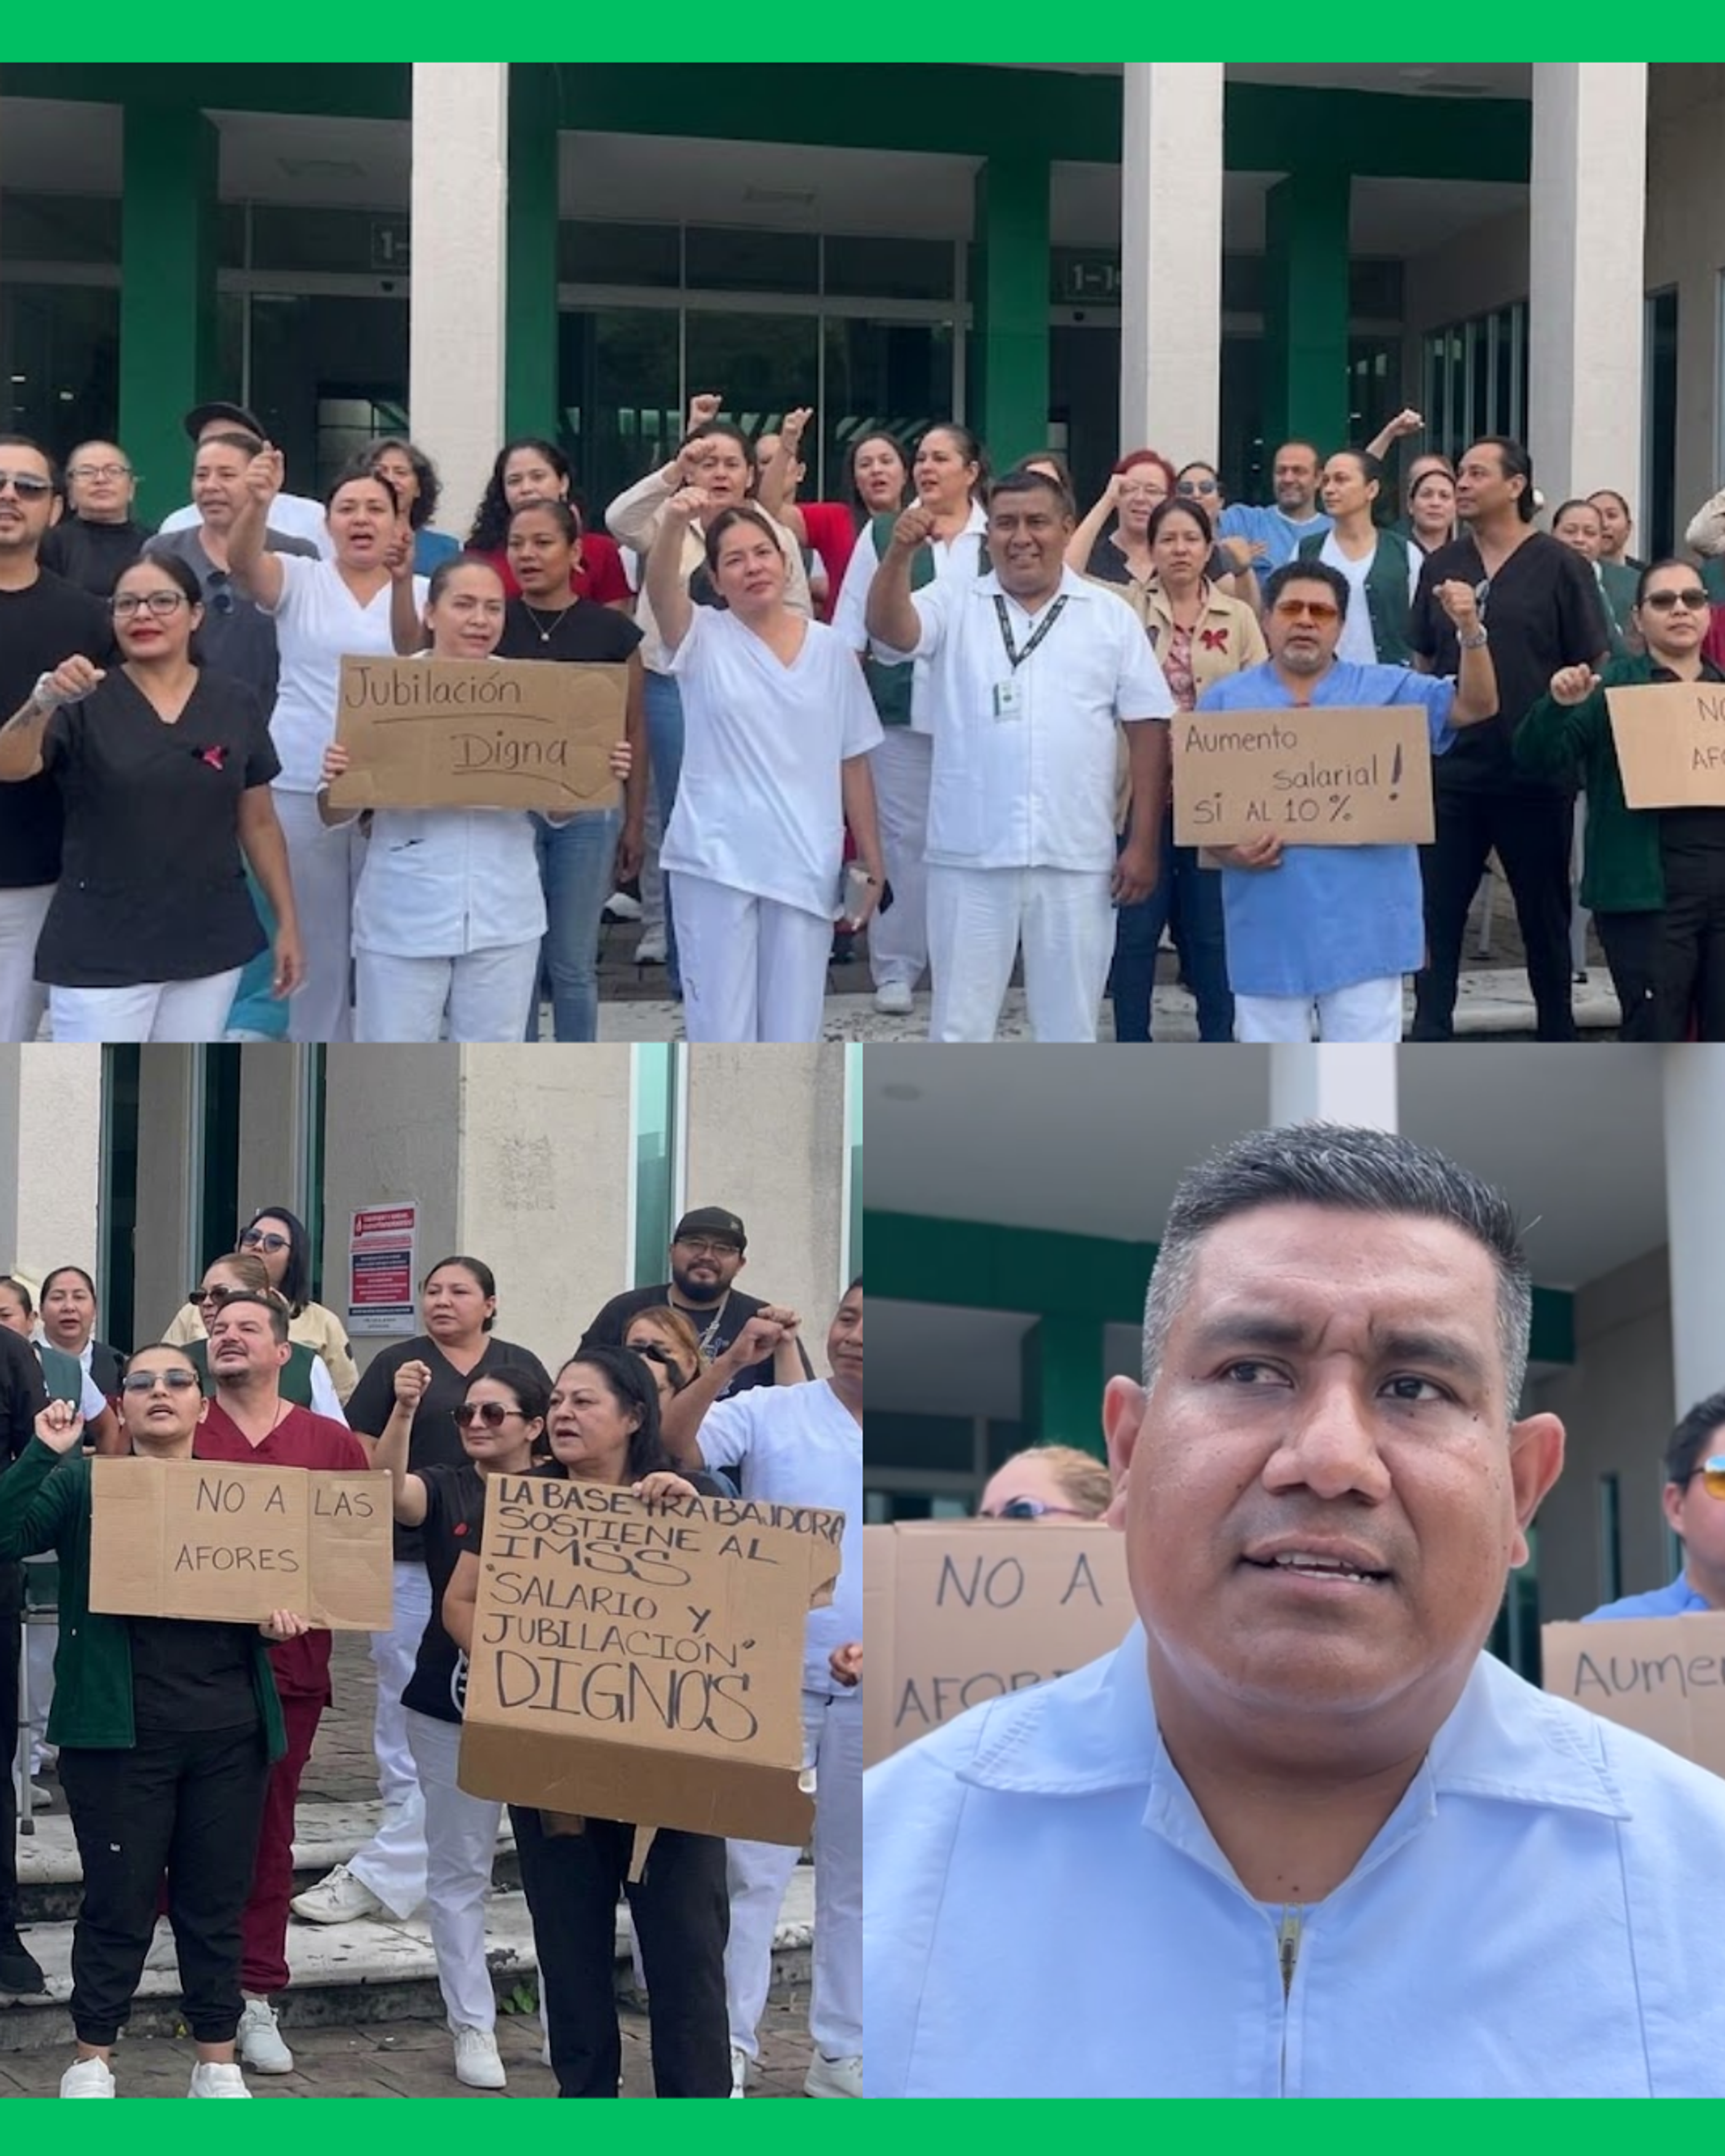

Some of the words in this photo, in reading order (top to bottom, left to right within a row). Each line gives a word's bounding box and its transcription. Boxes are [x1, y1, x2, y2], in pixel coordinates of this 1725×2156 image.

[345, 667, 522, 708] Jubilación
[451, 731, 568, 769] Digna
[1185, 725, 1298, 753] Aumento
[1246, 800, 1272, 822] AL
[196, 1478, 245, 1513] NO
[265, 1485, 285, 1513] A
[314, 1489, 374, 1517] LAS
[500, 1478, 534, 1505] LA
[542, 1483, 635, 1515] BASE
[499, 1507, 701, 1552] SOSTIENE
[719, 1534, 779, 1565] AL
[174, 1544, 299, 1573] AFORES
[491, 1534, 691, 1586] IMSS
[937, 1554, 1024, 1609] NO
[1060, 1552, 1103, 1607] A
[687, 1605, 711, 1633] Y
